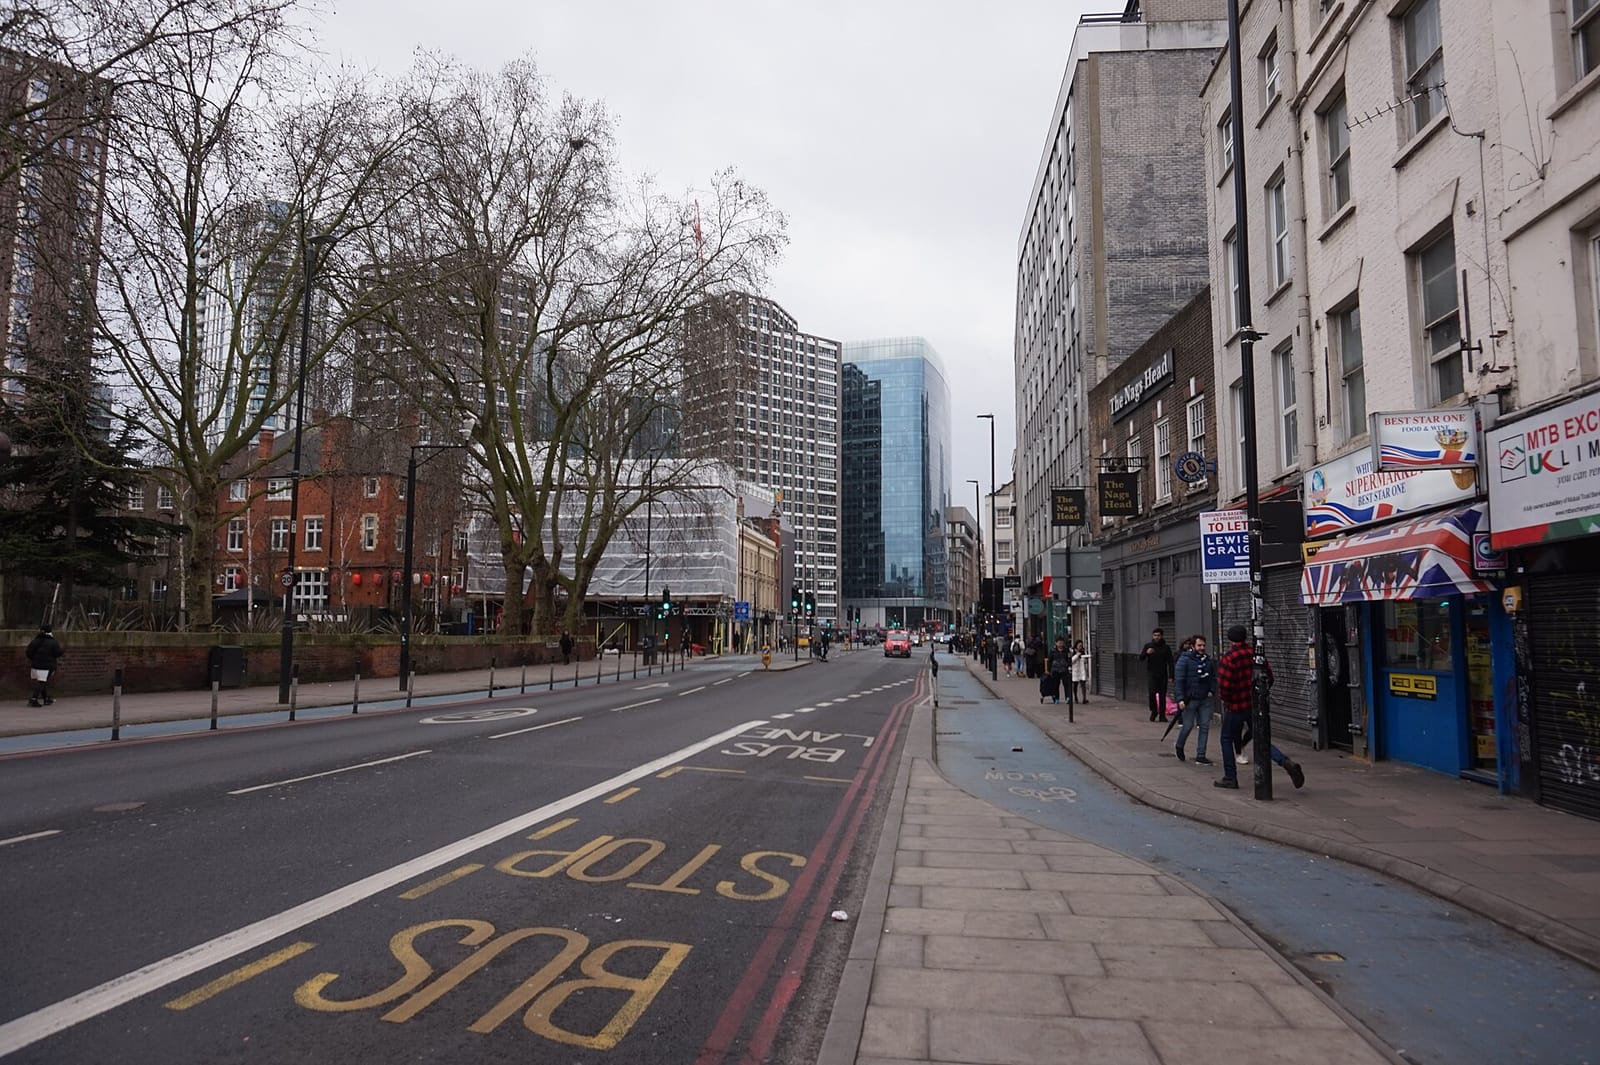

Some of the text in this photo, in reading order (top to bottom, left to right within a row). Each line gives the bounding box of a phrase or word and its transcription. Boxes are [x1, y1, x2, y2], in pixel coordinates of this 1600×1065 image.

[1109, 352, 1169, 415] The Nags Head
[1384, 413, 1466, 426] BEST STAR ONE
[1527, 408, 1600, 451] MTB EXC
[1355, 461, 1373, 475] WHIT
[1557, 474, 1571, 488] you
[1573, 470, 1587, 480] can
[1104, 491, 1130, 500] Nags
[1357, 481, 1406, 506] BEST STAR ONE
[1056, 504, 1078, 513] Nags
[1104, 500, 1132, 508] Head
[1208, 520, 1249, 532] TO LET
[1207, 534, 1249, 545] LEWIS
[1207, 544, 1250, 555] CRAIG
[282, 576, 292, 584] 20
[737, 727, 875, 747] LANE
[720, 742, 846, 763] BUS
[494, 834, 807, 900] STOP
[293, 918, 694, 1051] BUS
